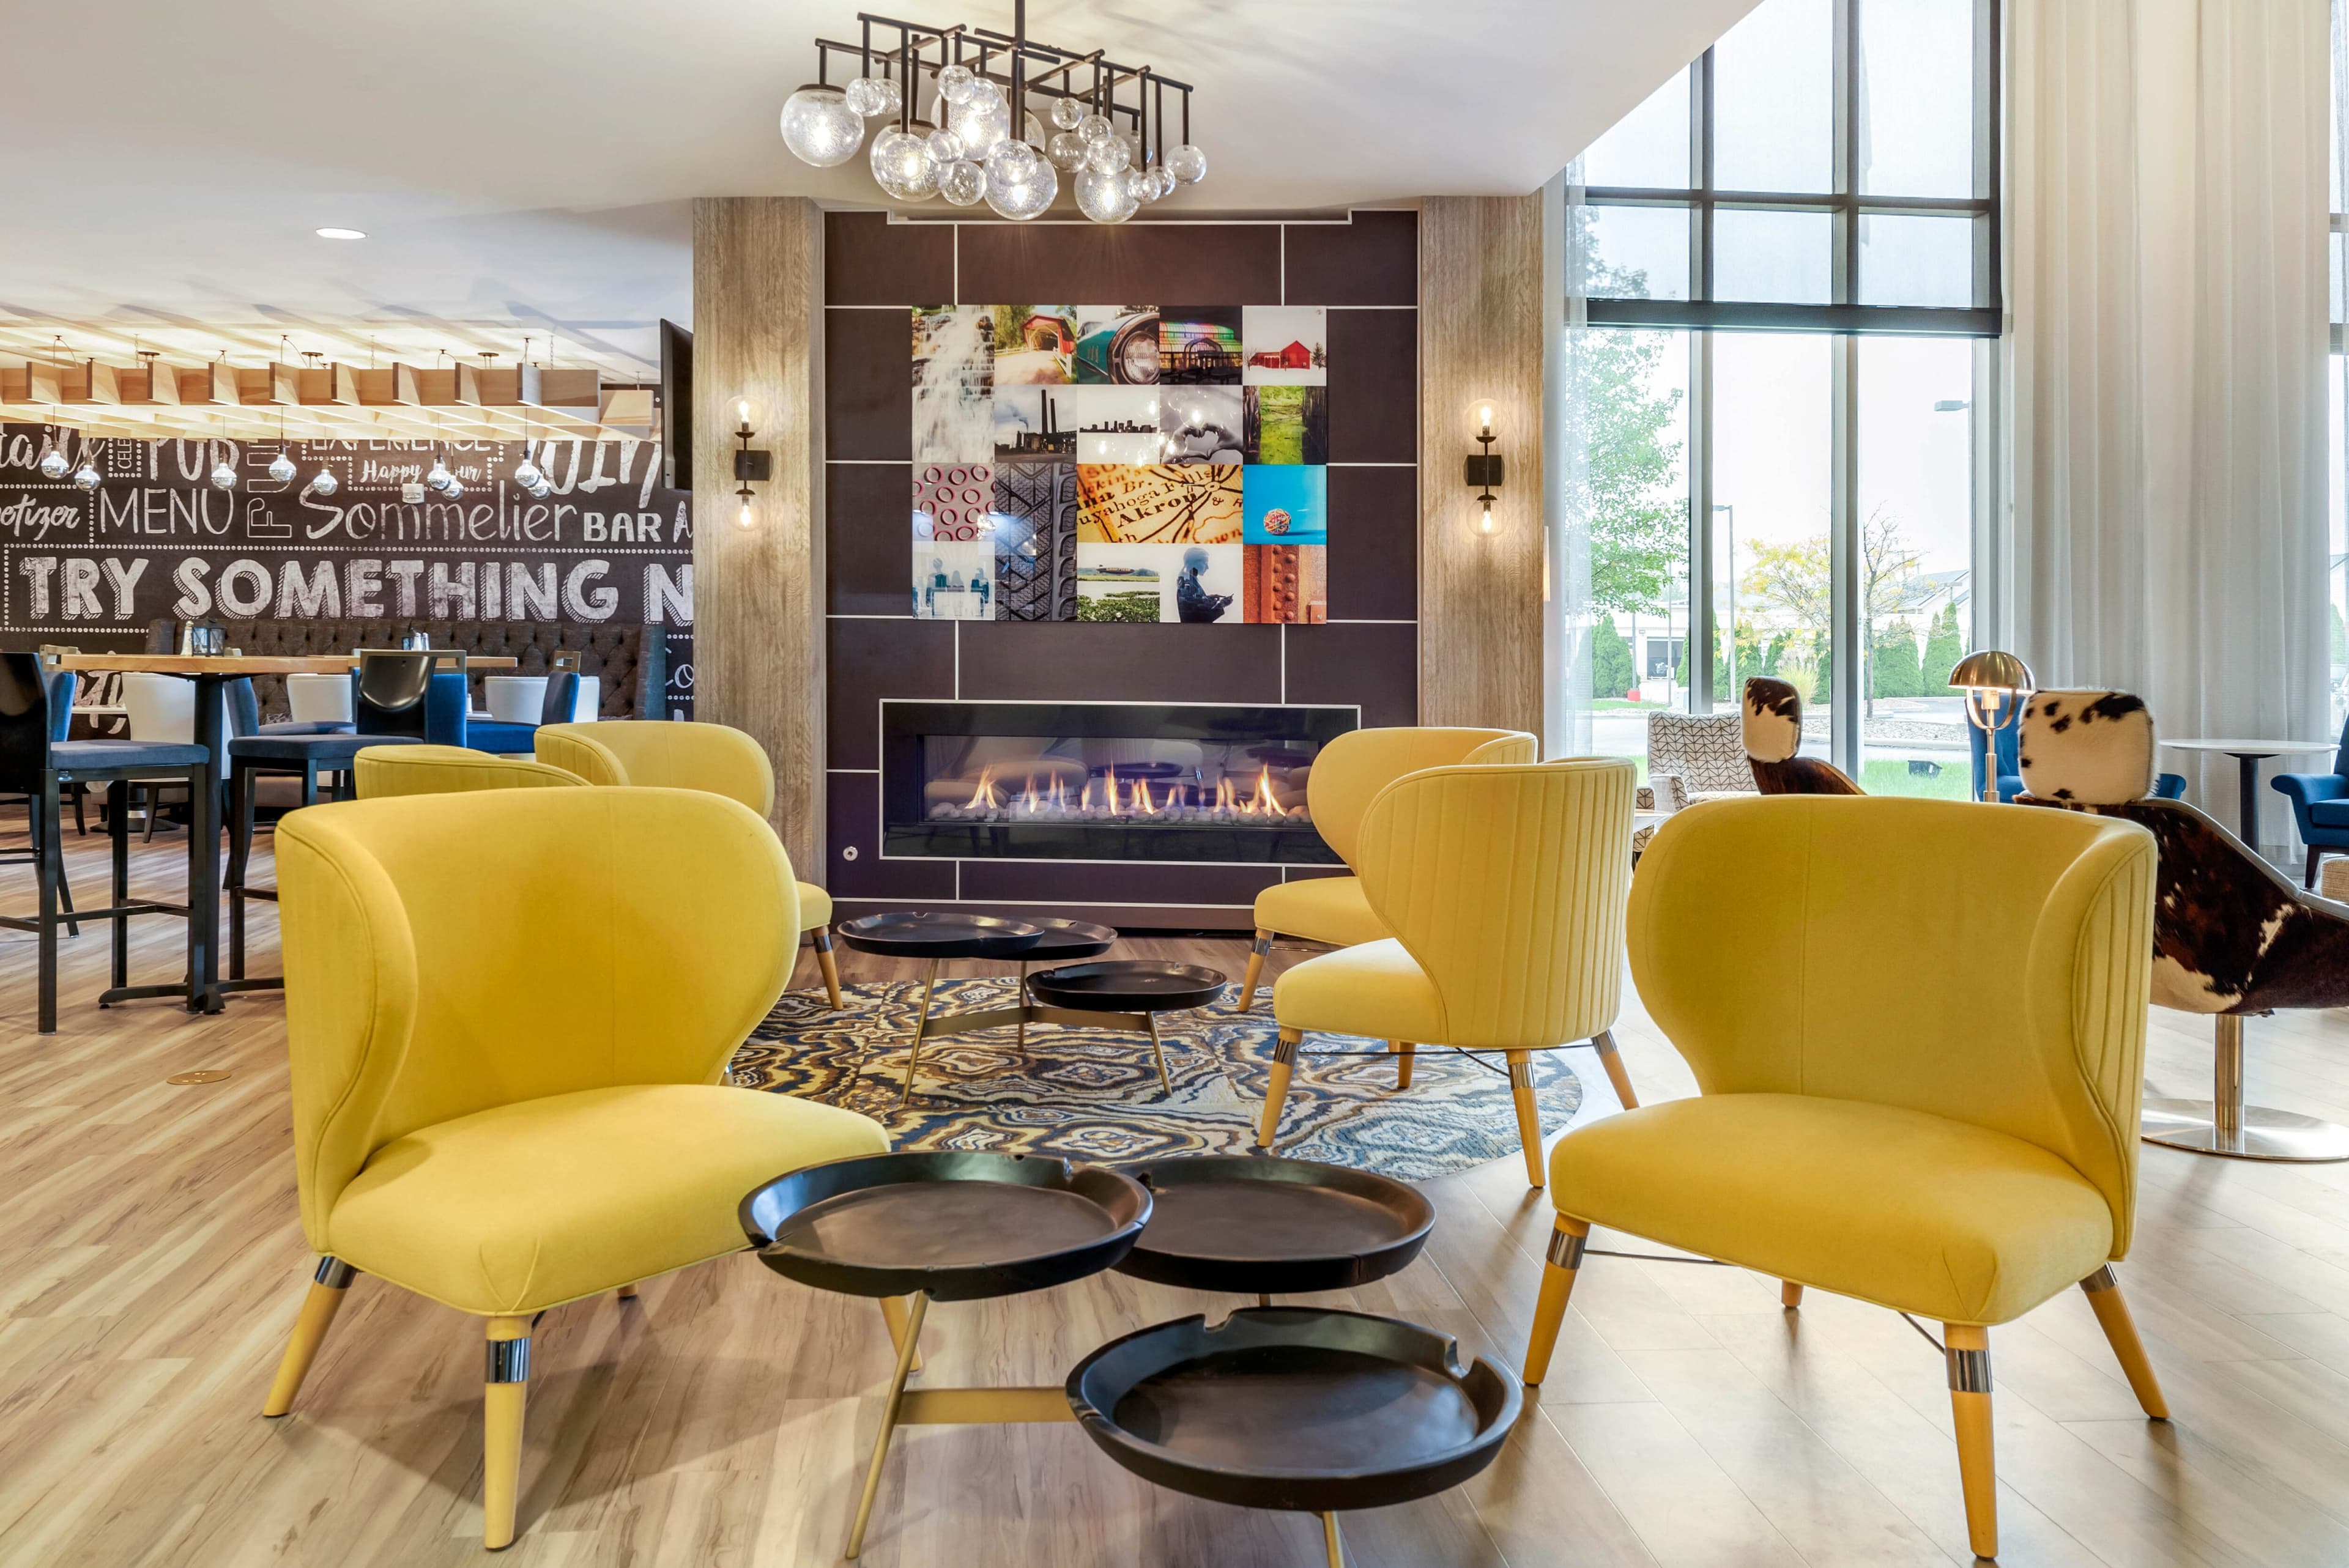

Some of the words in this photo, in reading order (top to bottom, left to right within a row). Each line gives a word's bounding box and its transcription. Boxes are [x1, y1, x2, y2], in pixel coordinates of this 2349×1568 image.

[117, 438, 132, 469] CELE
[360, 459, 423, 484] Happy
[0, 494, 80, 541] etizer
[100, 487, 234, 535] MENU
[299, 479, 577, 541] Sommelier
[584, 512, 662, 542] BAR
[1077, 490, 1160, 525] uyahoga
[20, 557, 149, 620] TRY
[173, 557, 619, 623] SOMETHING
